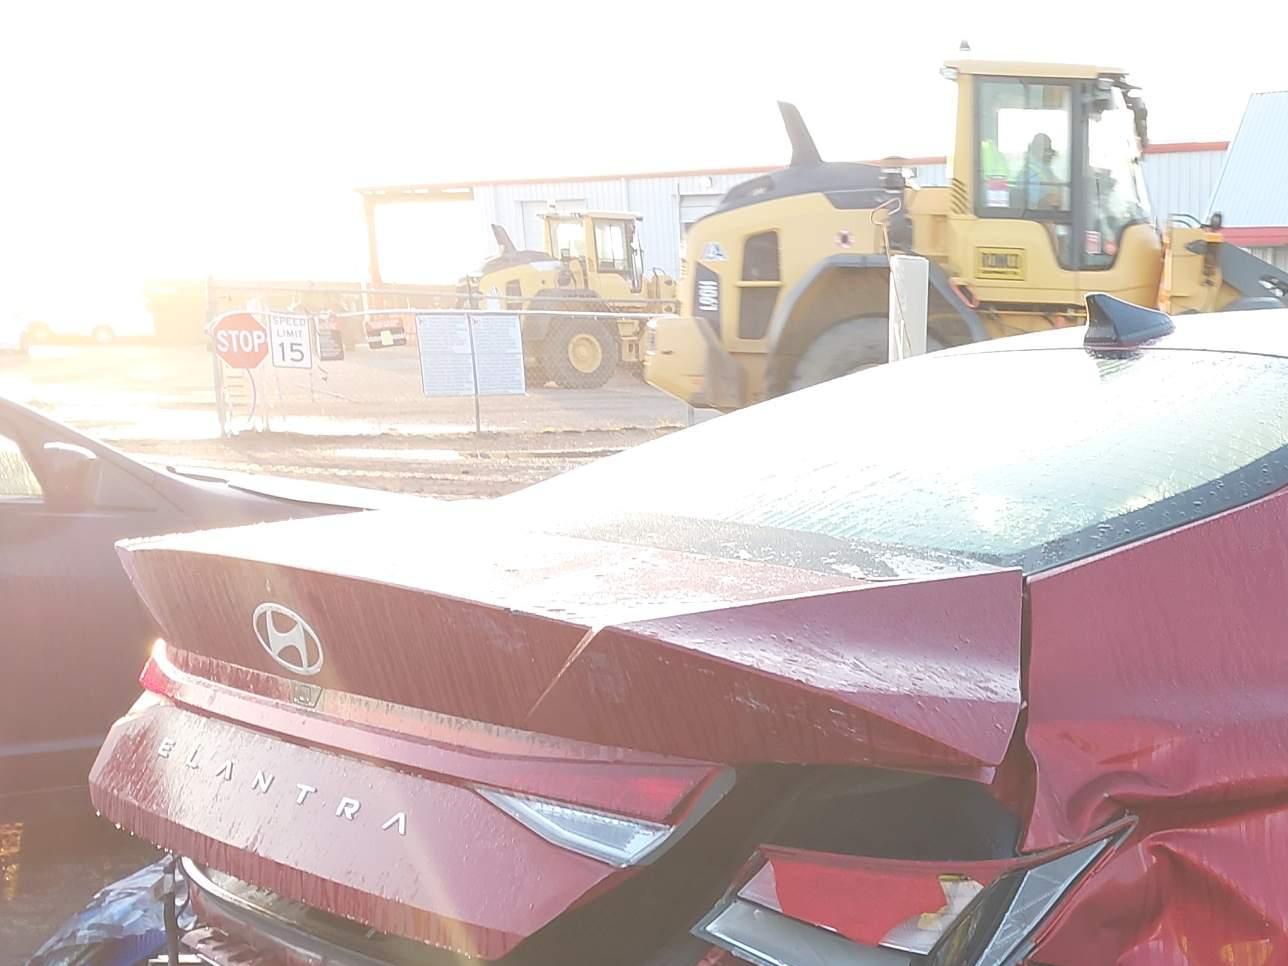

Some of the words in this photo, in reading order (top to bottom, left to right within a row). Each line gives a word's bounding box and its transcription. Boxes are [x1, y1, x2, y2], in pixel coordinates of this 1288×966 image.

[272, 316, 306, 327] SPEED
[216, 330, 266, 353] STOP
[277, 330, 303, 339] LIMIT
[279, 341, 305, 362] 15
[158, 736, 407, 834] ELANTRA
